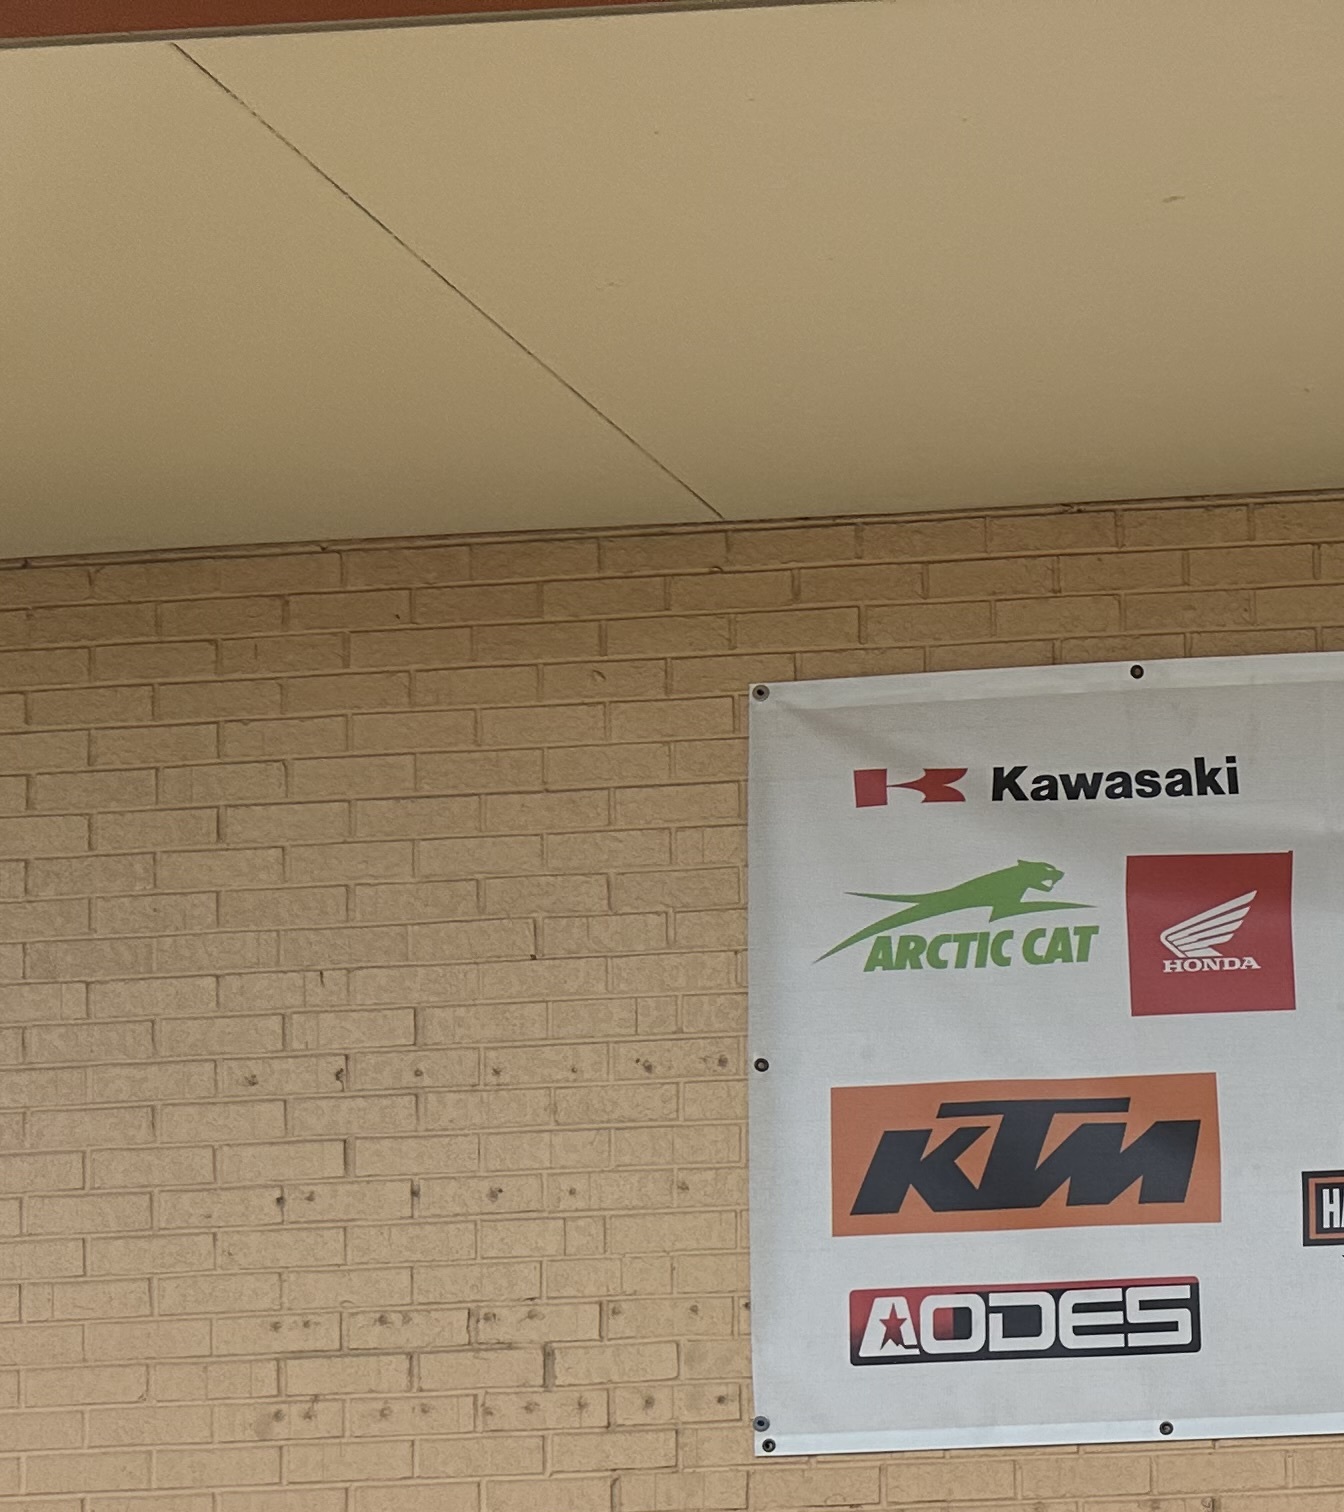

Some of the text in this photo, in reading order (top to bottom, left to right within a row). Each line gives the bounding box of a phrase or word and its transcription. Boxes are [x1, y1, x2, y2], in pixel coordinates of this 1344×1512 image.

[992, 756, 1240, 802] Kawasaki
[863, 924, 1101, 973] ARCTIC CAT
[1162, 955, 1262, 973] HONDA
[850, 1097, 1201, 1217] KTM
[859, 1286, 1192, 1357] AODES
